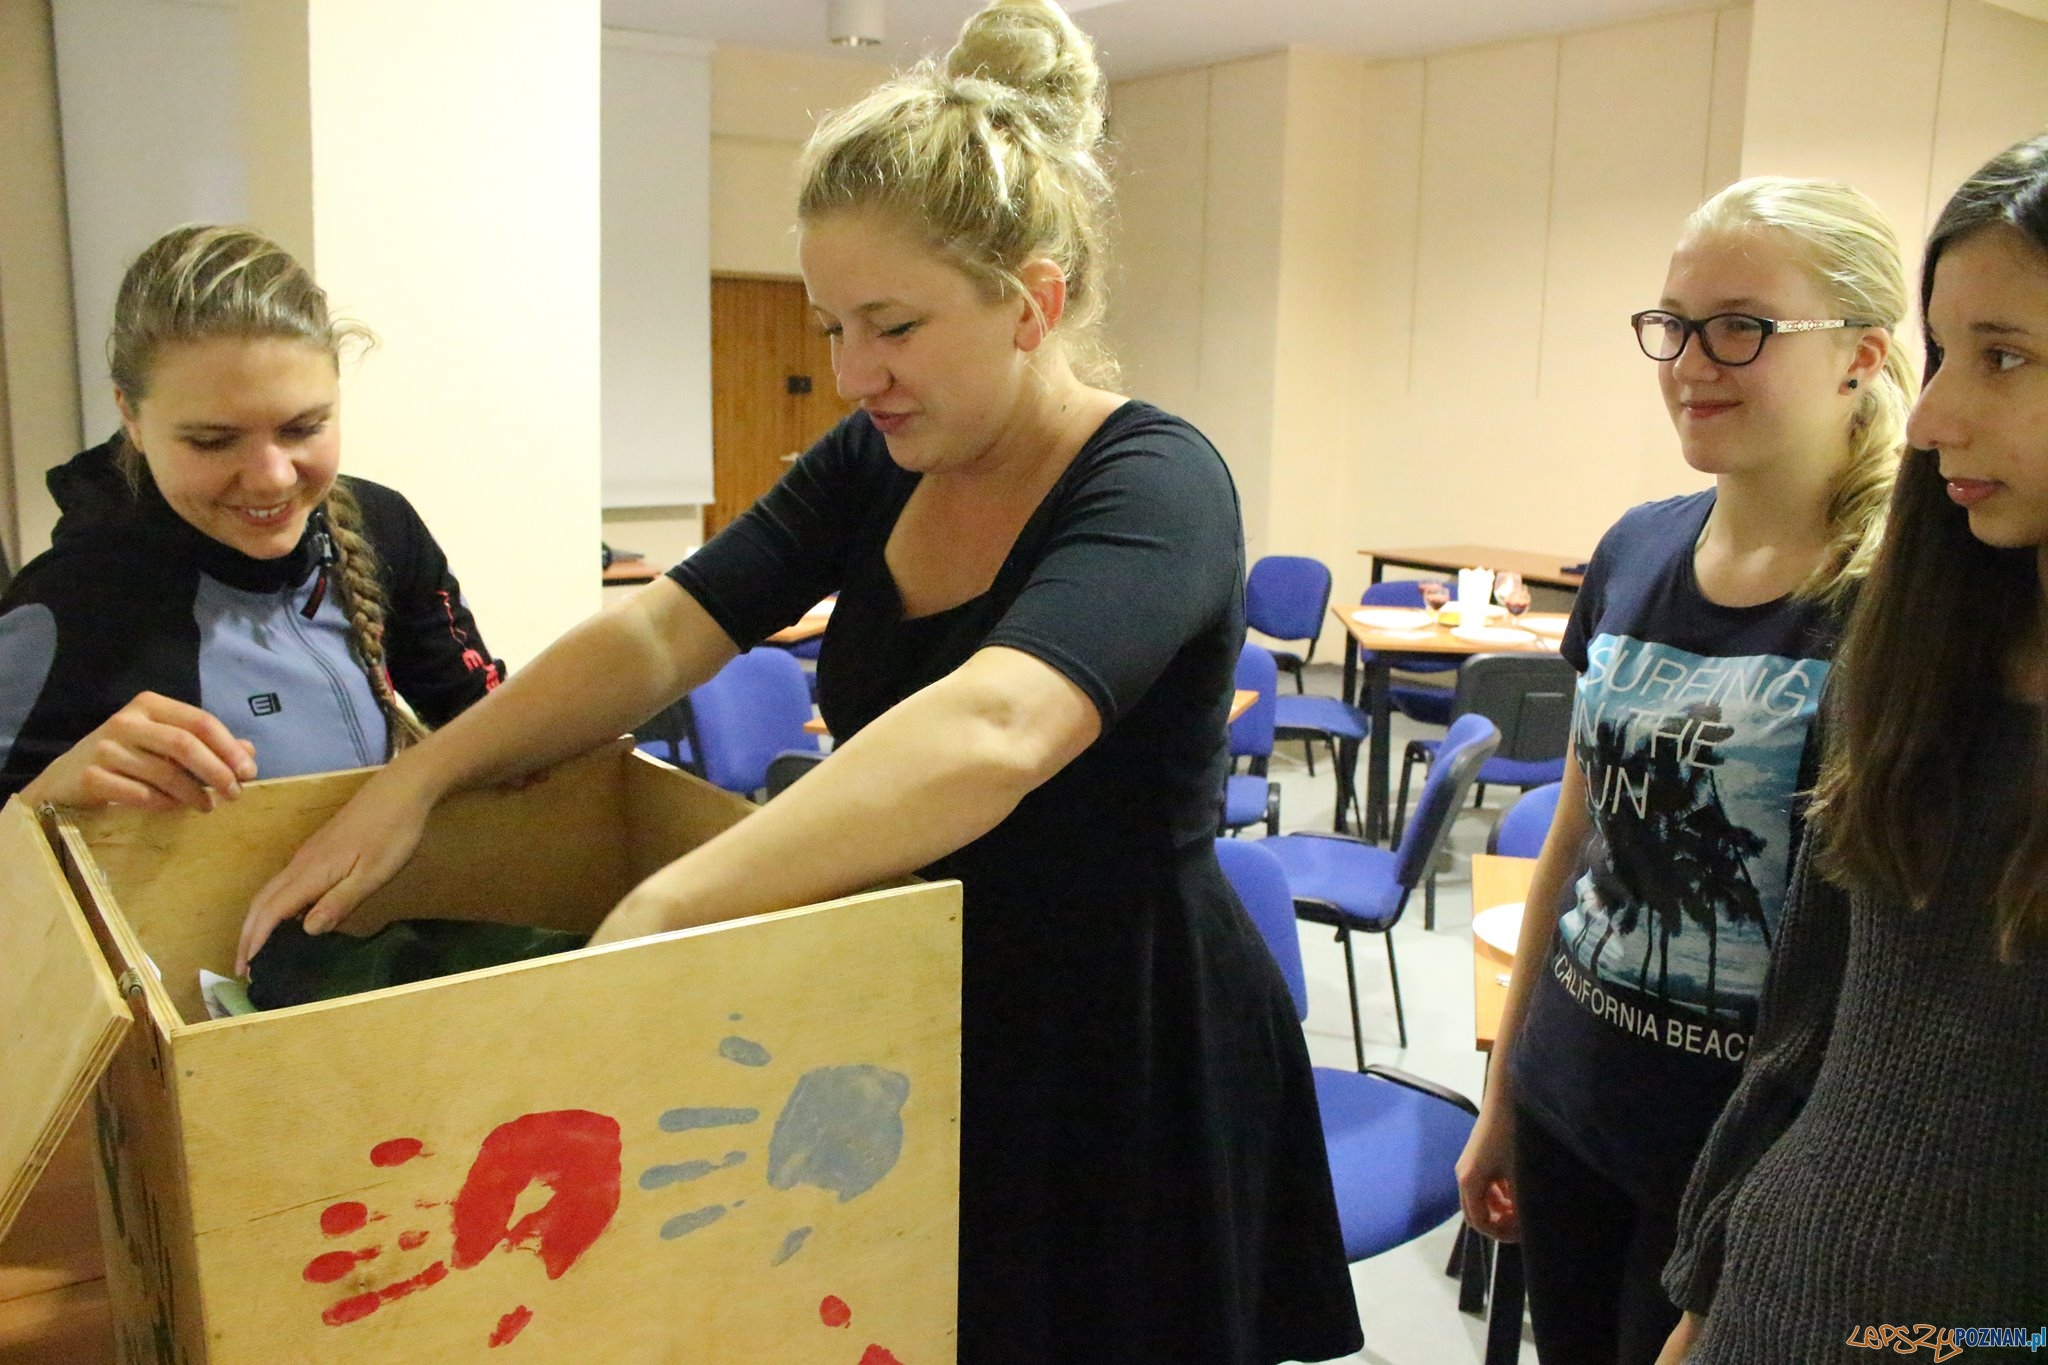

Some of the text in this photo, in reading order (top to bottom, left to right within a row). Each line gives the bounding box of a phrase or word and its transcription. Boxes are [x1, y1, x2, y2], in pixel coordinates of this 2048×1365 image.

[1584, 646, 1810, 718] SURFING
[1629, 706, 1730, 769] THE
[1578, 754, 1650, 819] UN
[1554, 954, 1659, 1042] CALIFORNIA
